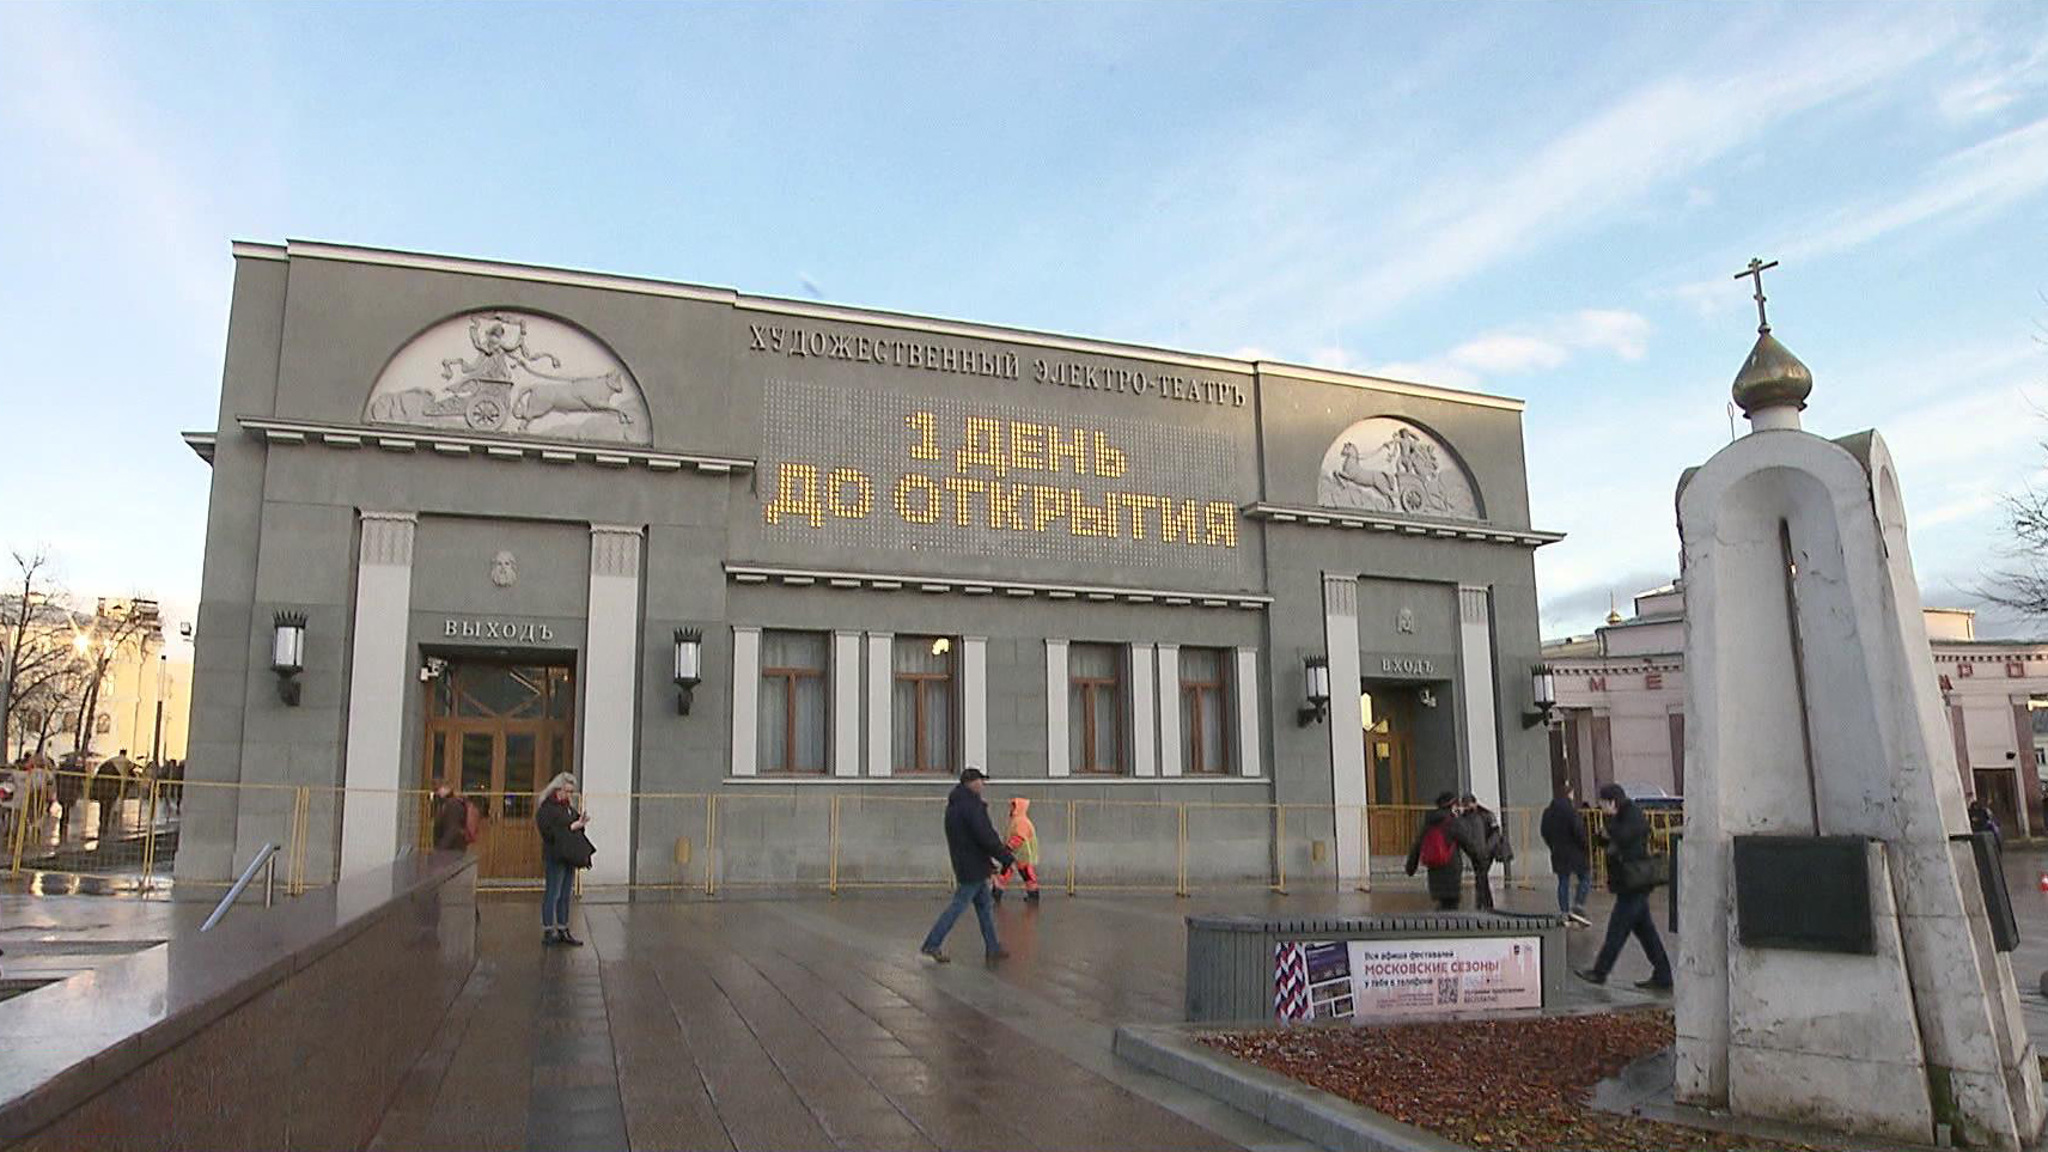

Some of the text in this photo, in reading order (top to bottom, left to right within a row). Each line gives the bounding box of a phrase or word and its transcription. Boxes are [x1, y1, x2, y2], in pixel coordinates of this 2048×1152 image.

[750, 322, 1247, 408] ХУДОЖЕСТВЕННЫЙ ЭЛЕКТРО-ТЕАТРЪ
[904, 410, 1128, 478] 1 ДЕНЬ
[764, 462, 1238, 548] ДО ОТКРЫТИЯ
[444, 618, 554, 642] ВЫХОДЪ
[1381, 658, 1434, 675] ВХОДЪ
[1364, 960, 1499, 976] МОСКОВСКИЕ СЕЗОНЫ
